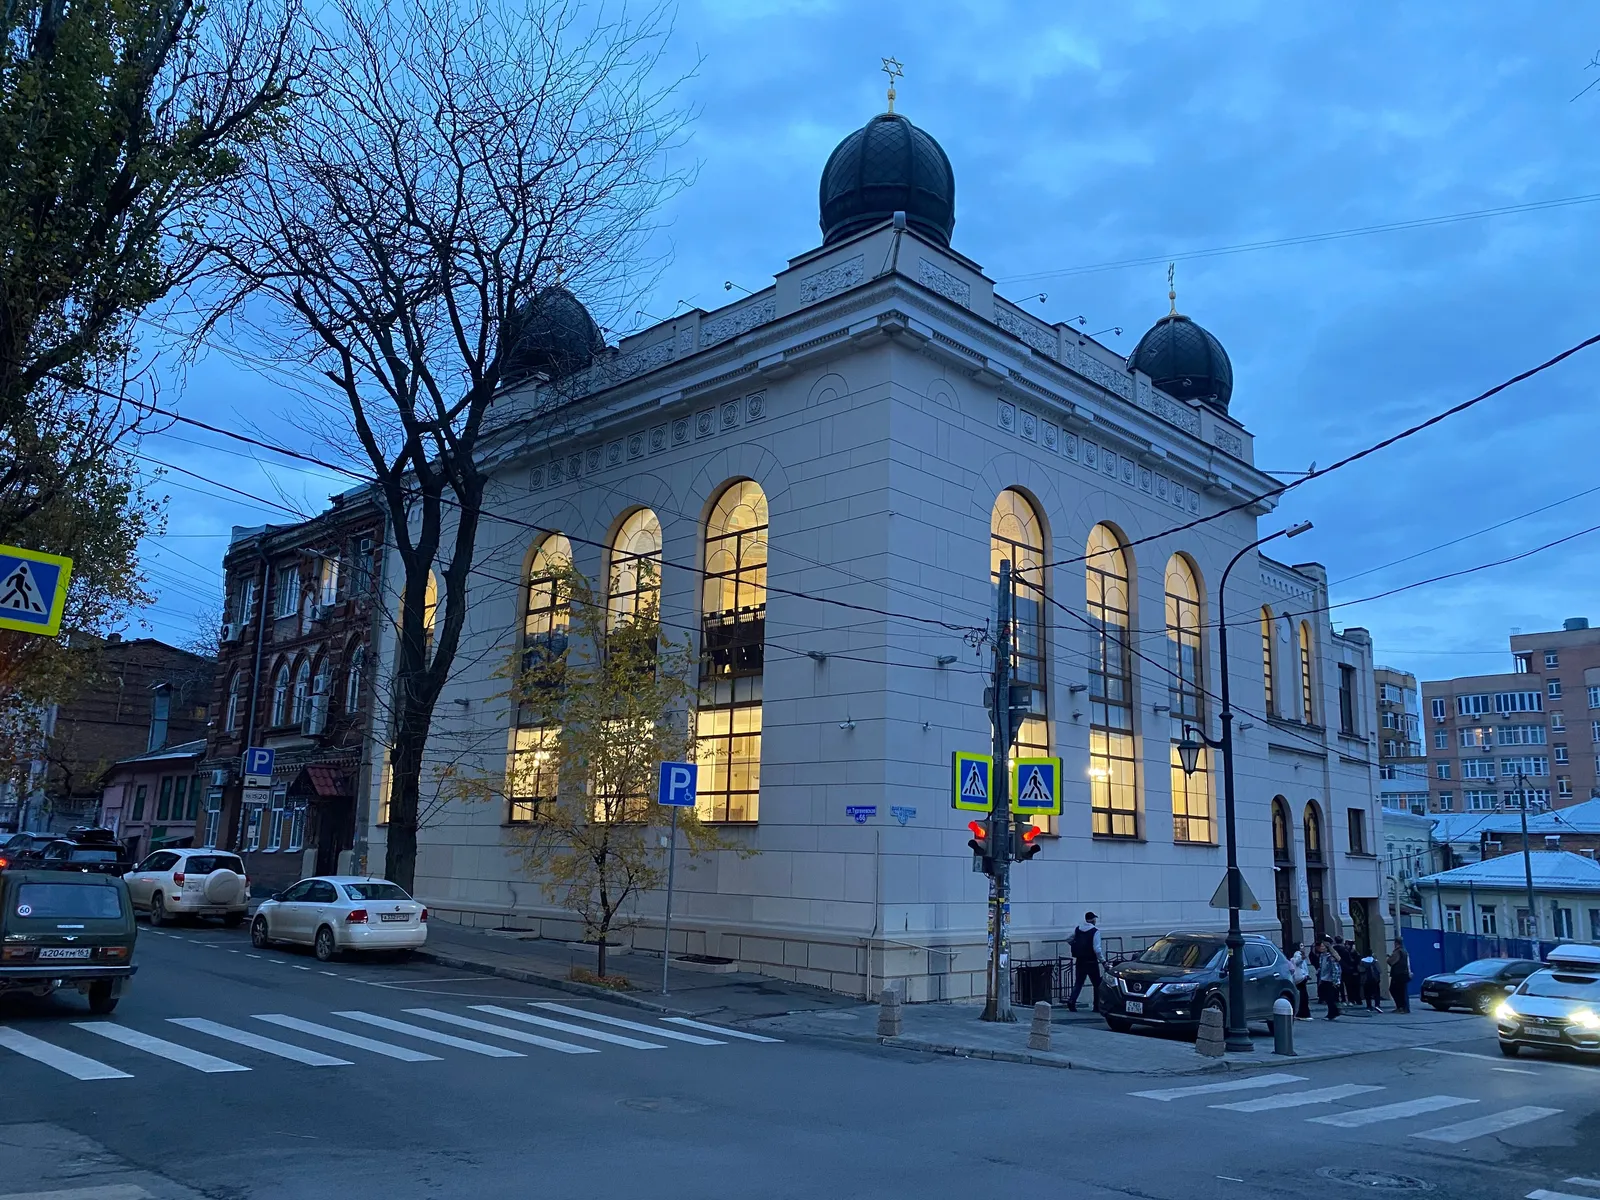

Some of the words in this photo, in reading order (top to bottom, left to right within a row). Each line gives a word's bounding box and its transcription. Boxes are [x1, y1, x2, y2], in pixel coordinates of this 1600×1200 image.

[253, 751, 270, 772] P
[669, 767, 691, 800] P
[20, 906, 30, 914] 60
